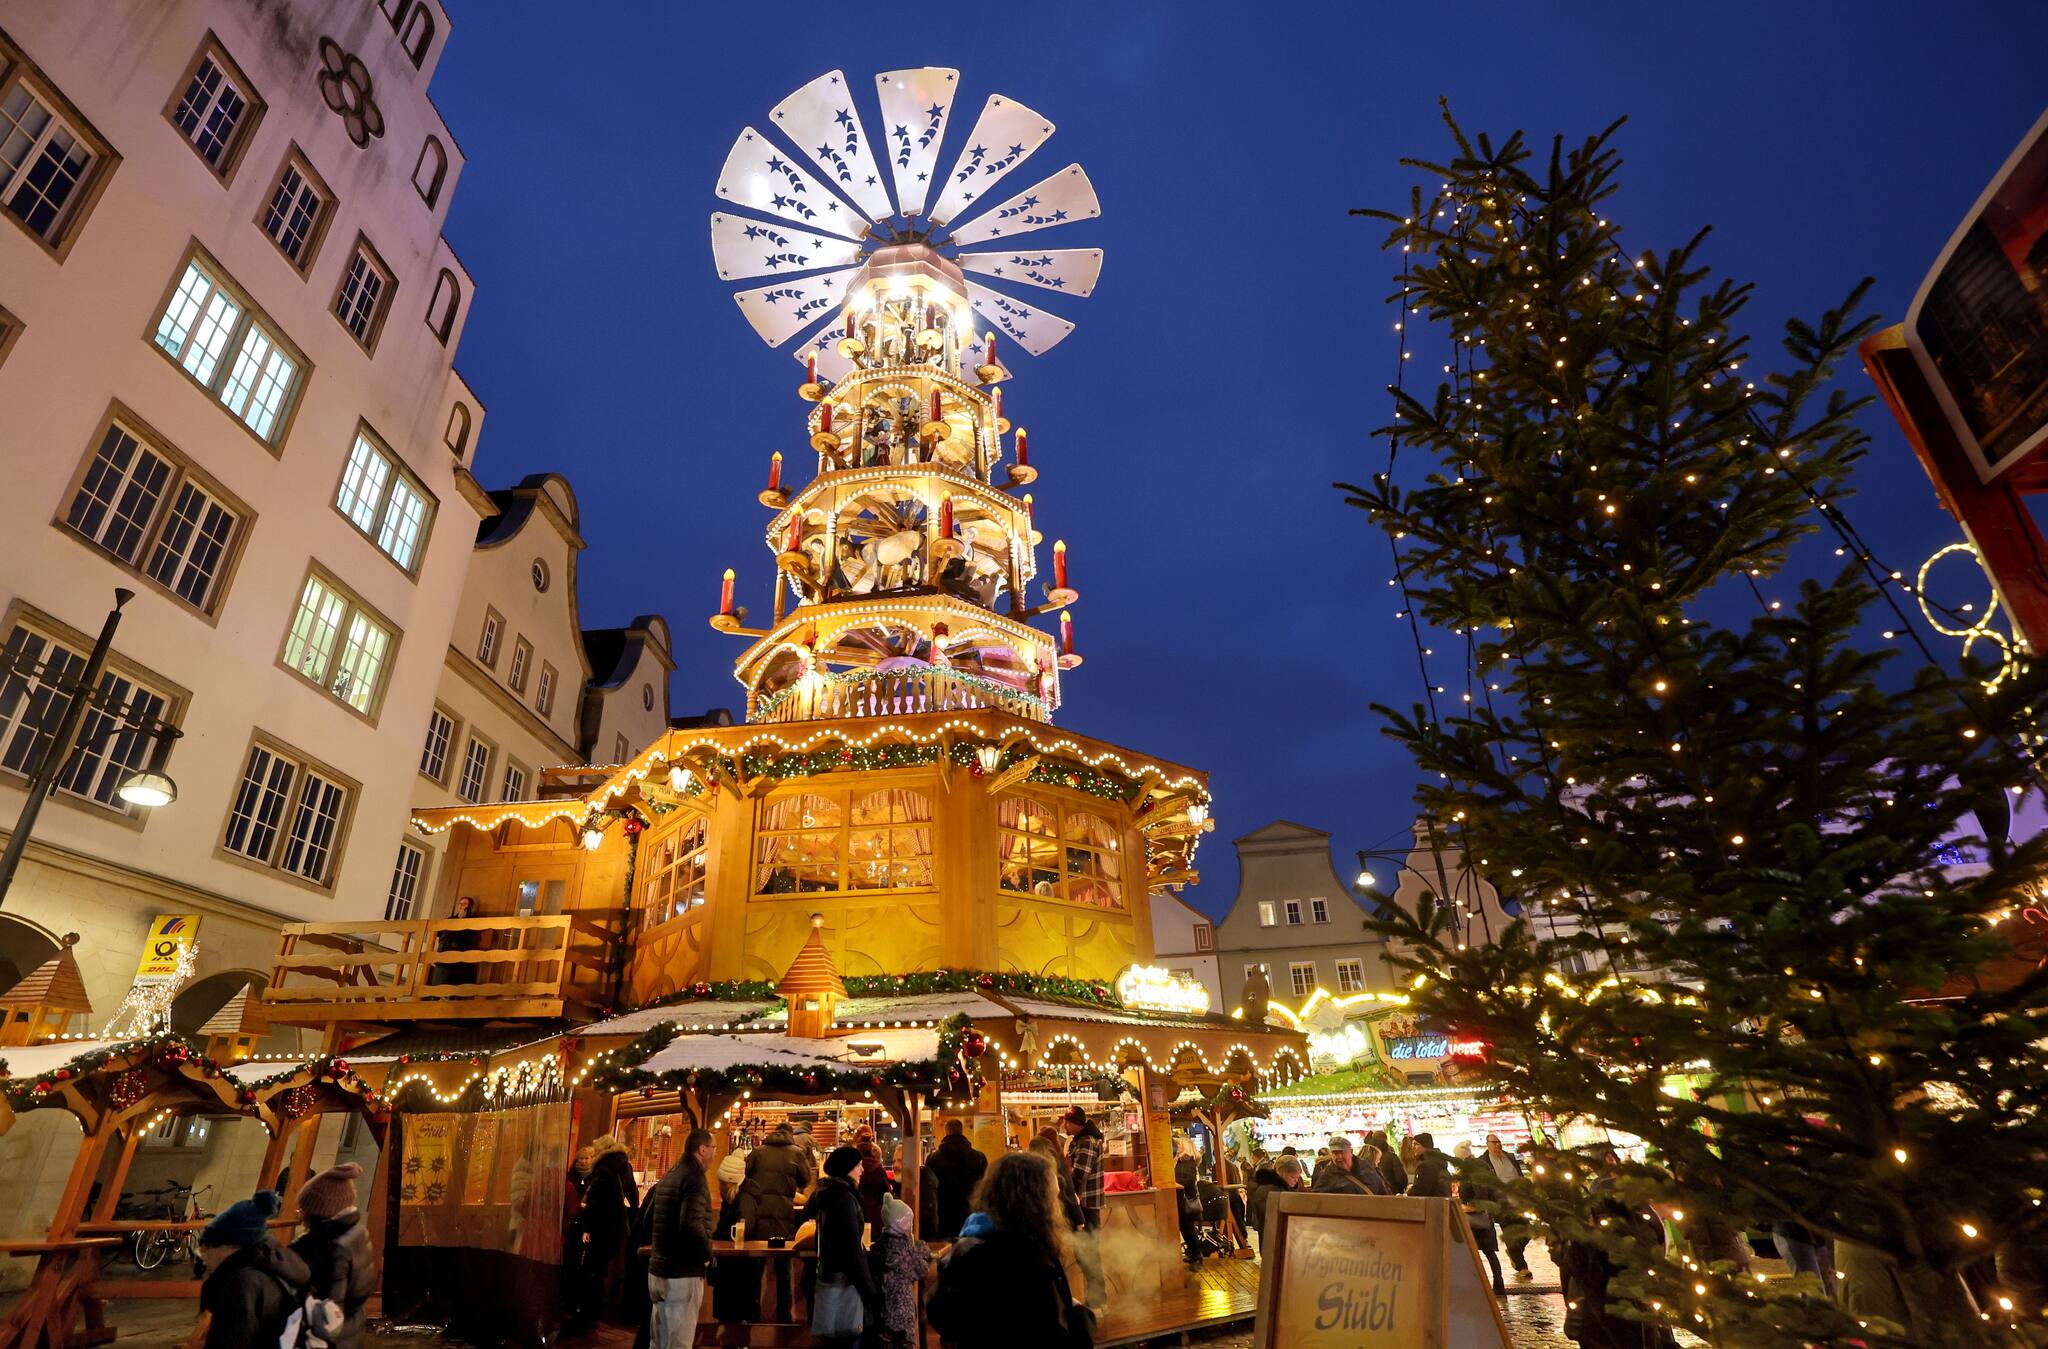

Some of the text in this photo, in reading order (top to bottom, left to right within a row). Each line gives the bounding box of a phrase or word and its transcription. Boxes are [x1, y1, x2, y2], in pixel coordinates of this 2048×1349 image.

[1391, 1042, 1412, 1059] die
[1415, 1039, 1448, 1059] total
[1303, 1249, 1403, 1282] Pyramiden
[1315, 1282, 1397, 1332] Stübl
